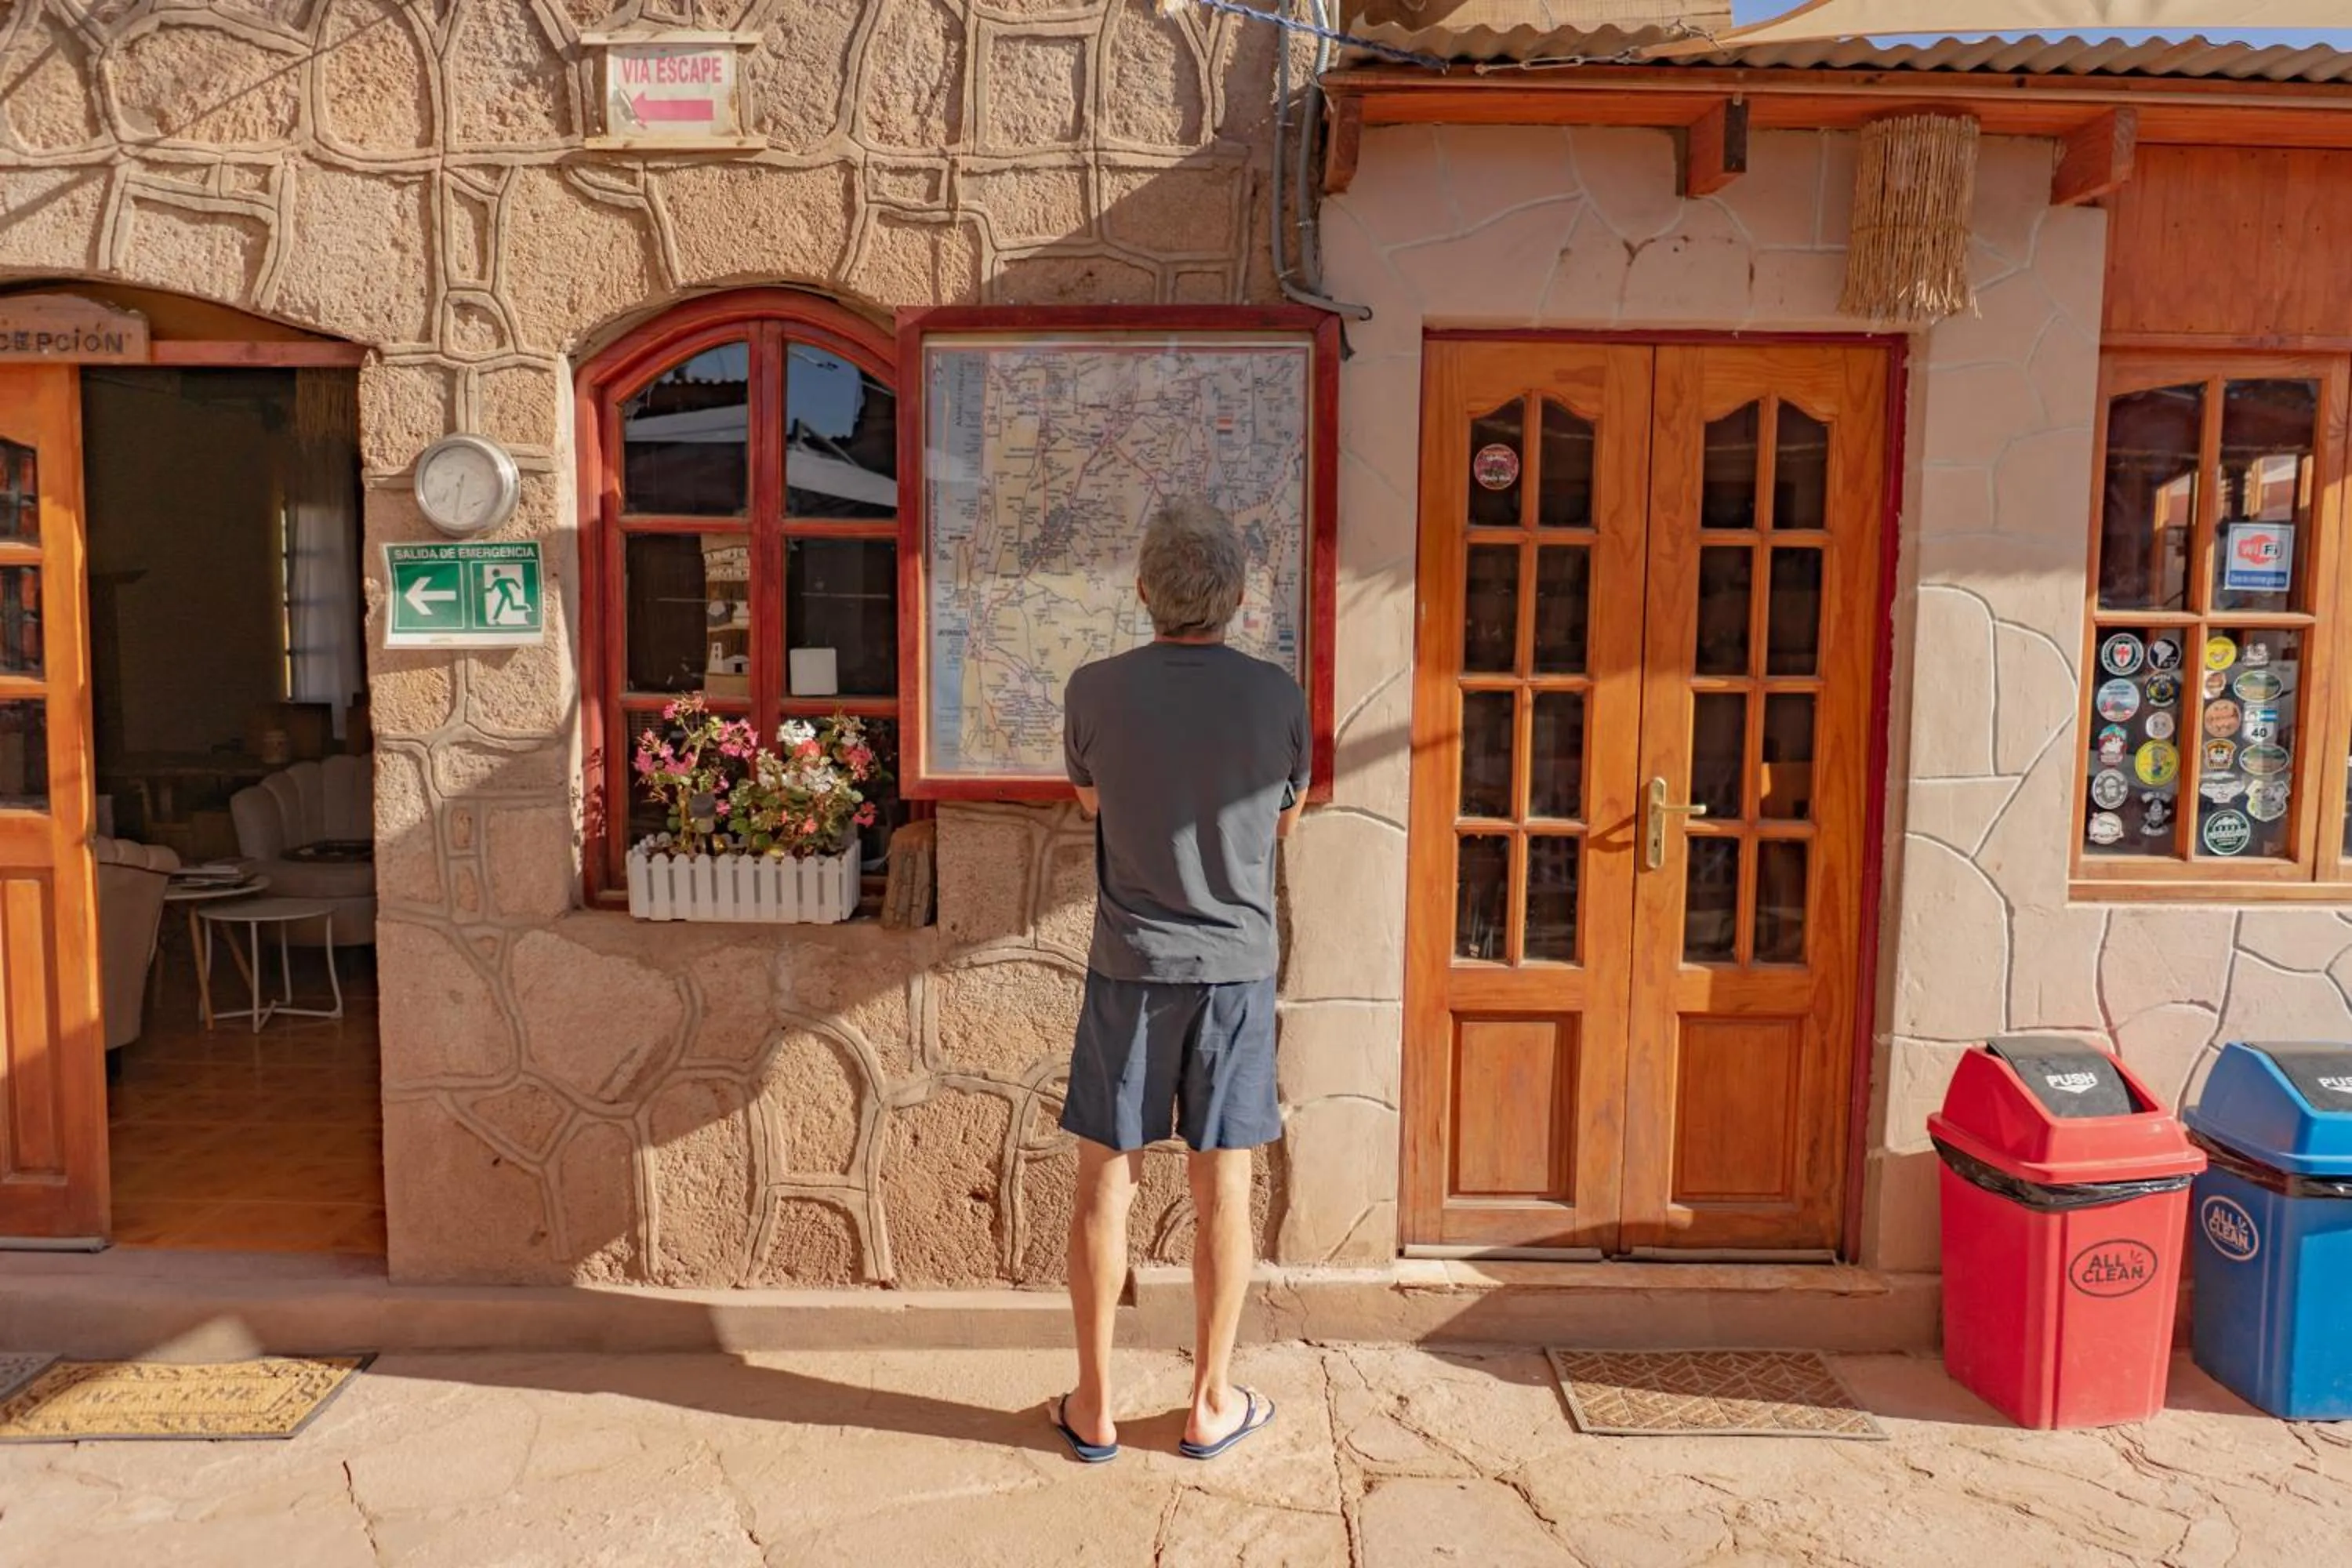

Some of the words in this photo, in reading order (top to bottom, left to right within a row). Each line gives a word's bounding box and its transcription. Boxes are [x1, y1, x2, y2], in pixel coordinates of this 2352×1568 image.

[622, 58, 651, 83] VIA
[656, 57, 722, 83] ESCAPE
[394, 549, 437, 560] SALIDA
[439, 549, 456, 559] DE
[459, 547, 535, 558] EMERGENCIA
[2251, 728, 2268, 738] 40
[2045, 1073, 2098, 1087] PUSH
[2212, 1206, 2241, 1229] ALL
[2209, 1218, 2250, 1250] CLEAN
[2089, 1254, 2125, 1269] ALL
[2082, 1265, 2144, 1283] CLEAN
